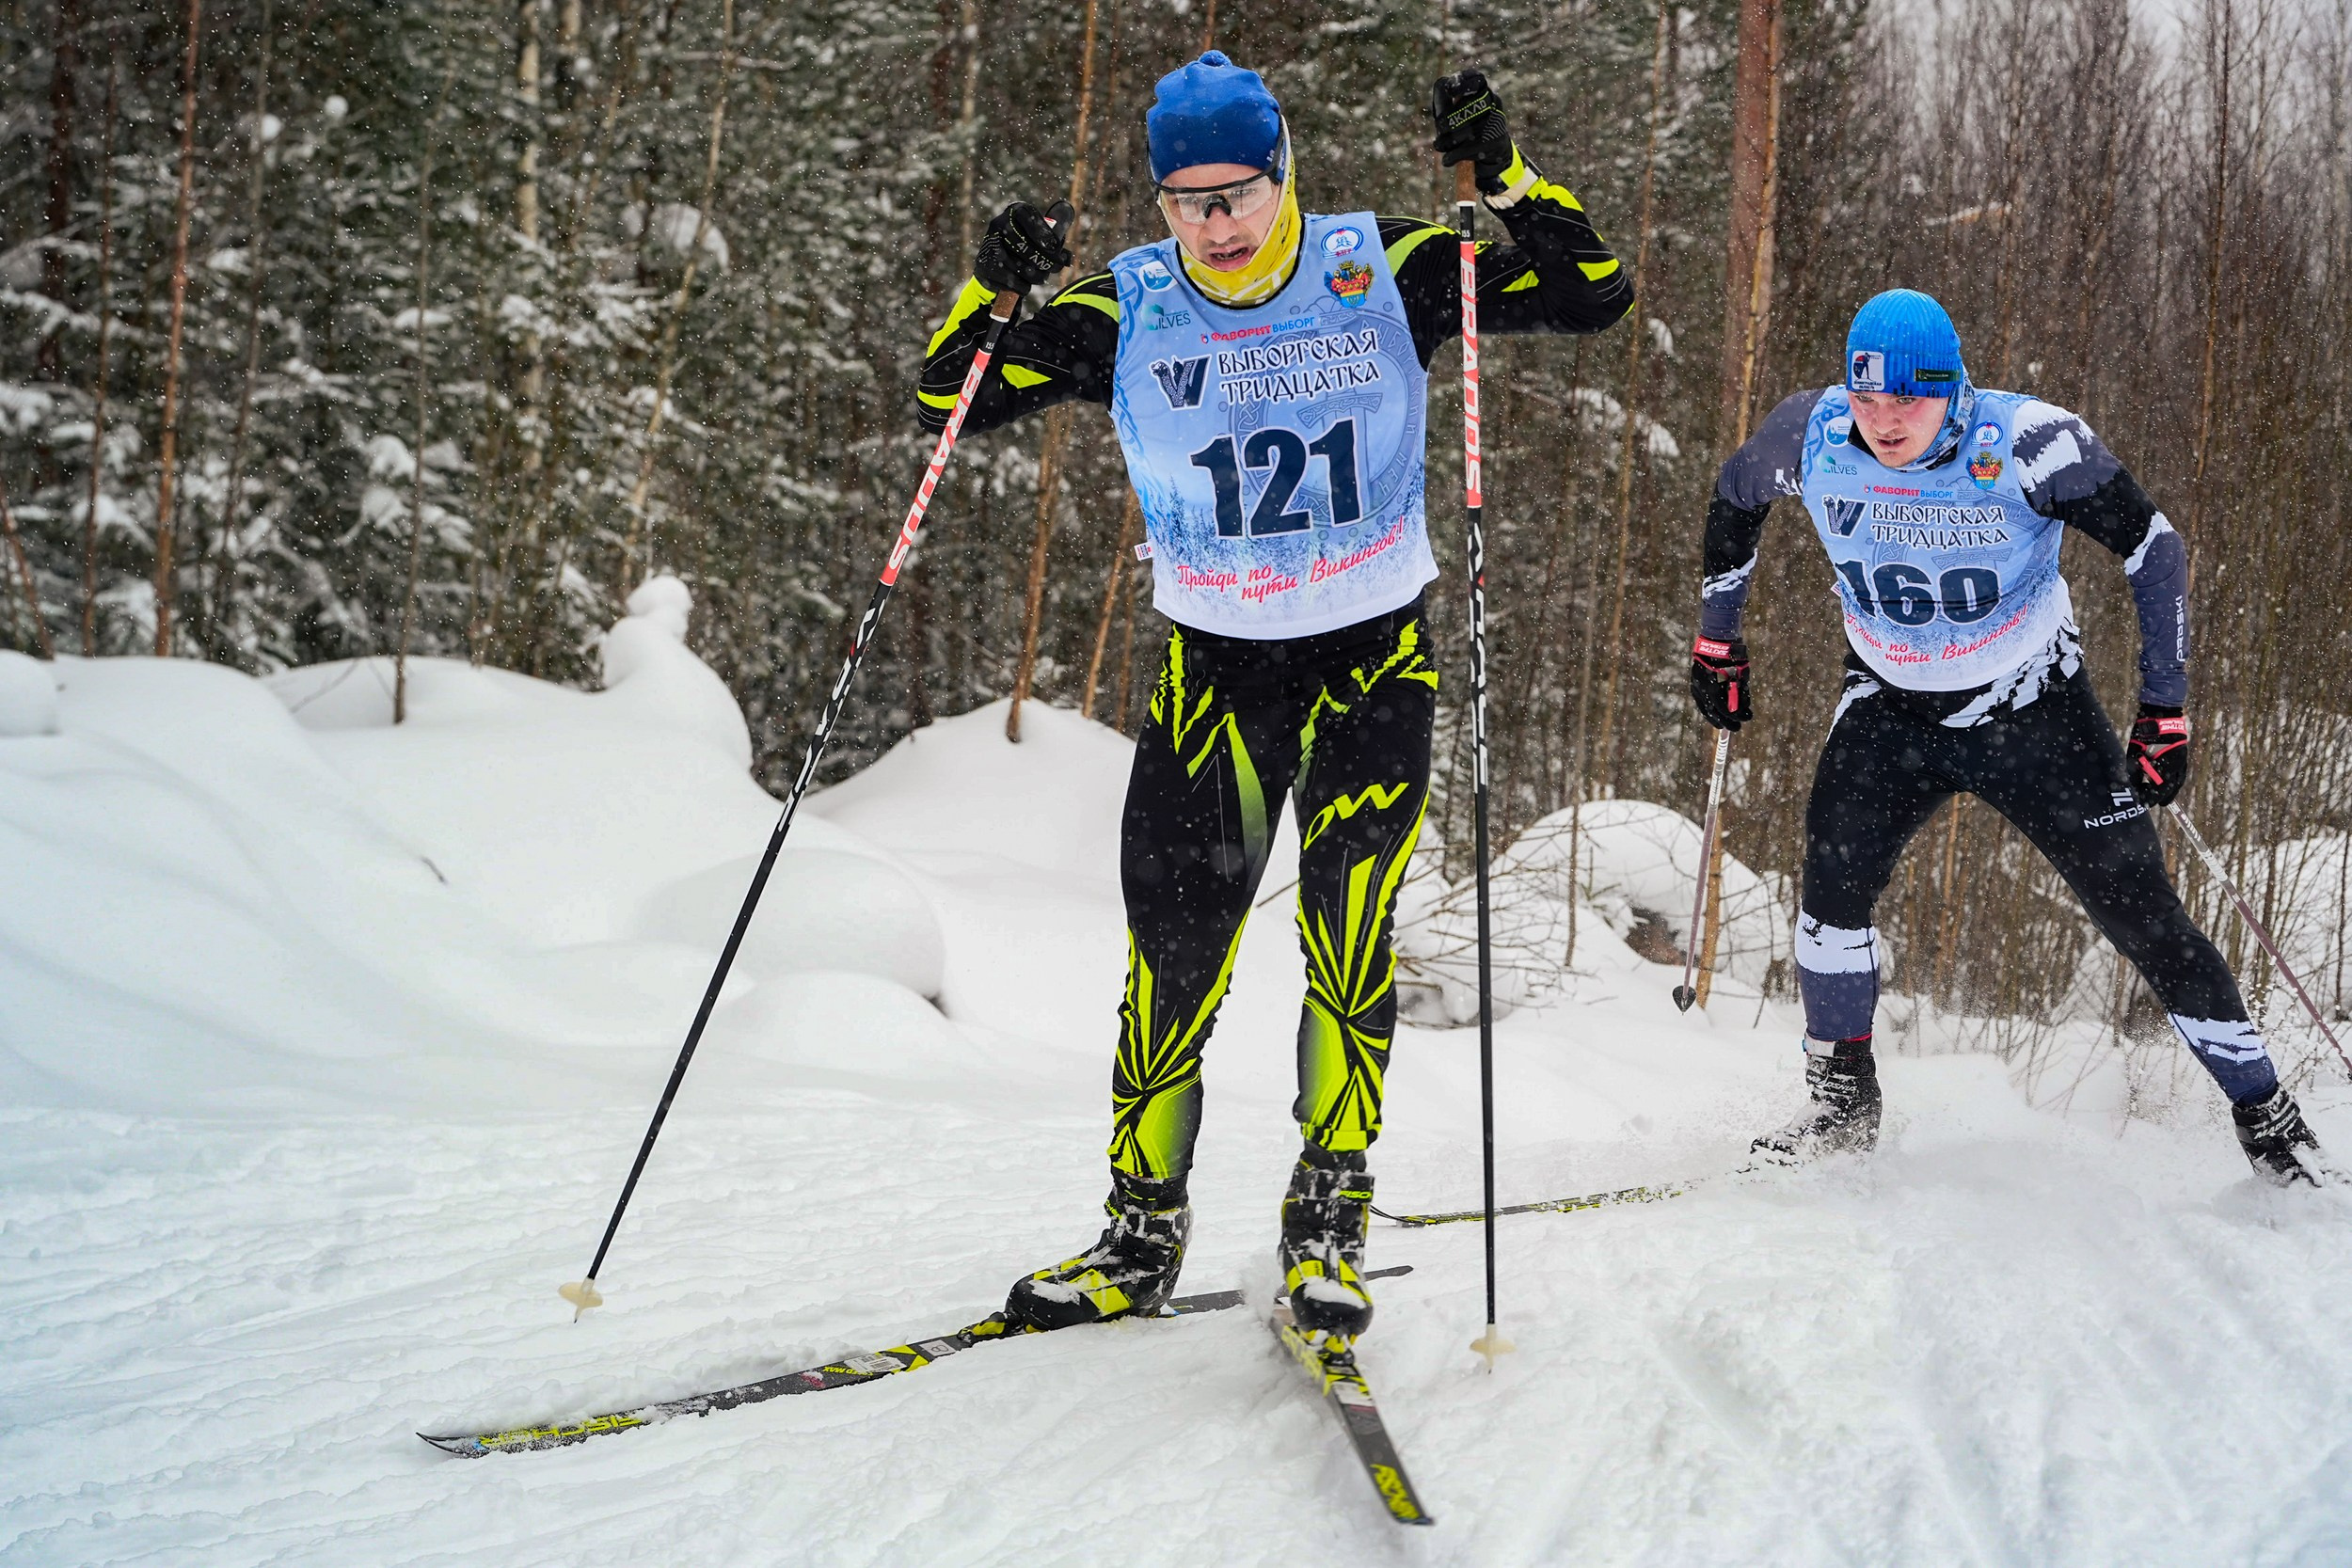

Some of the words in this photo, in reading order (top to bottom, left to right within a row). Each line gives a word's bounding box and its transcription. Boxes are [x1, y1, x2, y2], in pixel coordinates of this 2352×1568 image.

[1218, 330, 1380, 374] ВЫБОРГСКАЯ
[1220, 360, 1380, 403] ТРИДЦАТКА
[1460, 257, 1481, 494] BRADOS
[888, 362, 984, 570] BRADOS
[1190, 418, 1363, 538] 121
[1872, 502, 2006, 525] ВЫБОРГСКАЯ
[1241, 575, 1297, 603] пути
[1310, 515, 1404, 584] Викингов!
[1871, 525, 2010, 549] ТРИДЦАТКА
[1178, 564, 1238, 593] Пройди
[1248, 565, 1273, 583] по
[1835, 560, 2001, 627] 160
[1885, 652, 1931, 666] пути
[1942, 604, 2027, 660] Викингов!
[1889, 643, 1909, 653] по
[2083, 803, 2152, 829] NORDS
